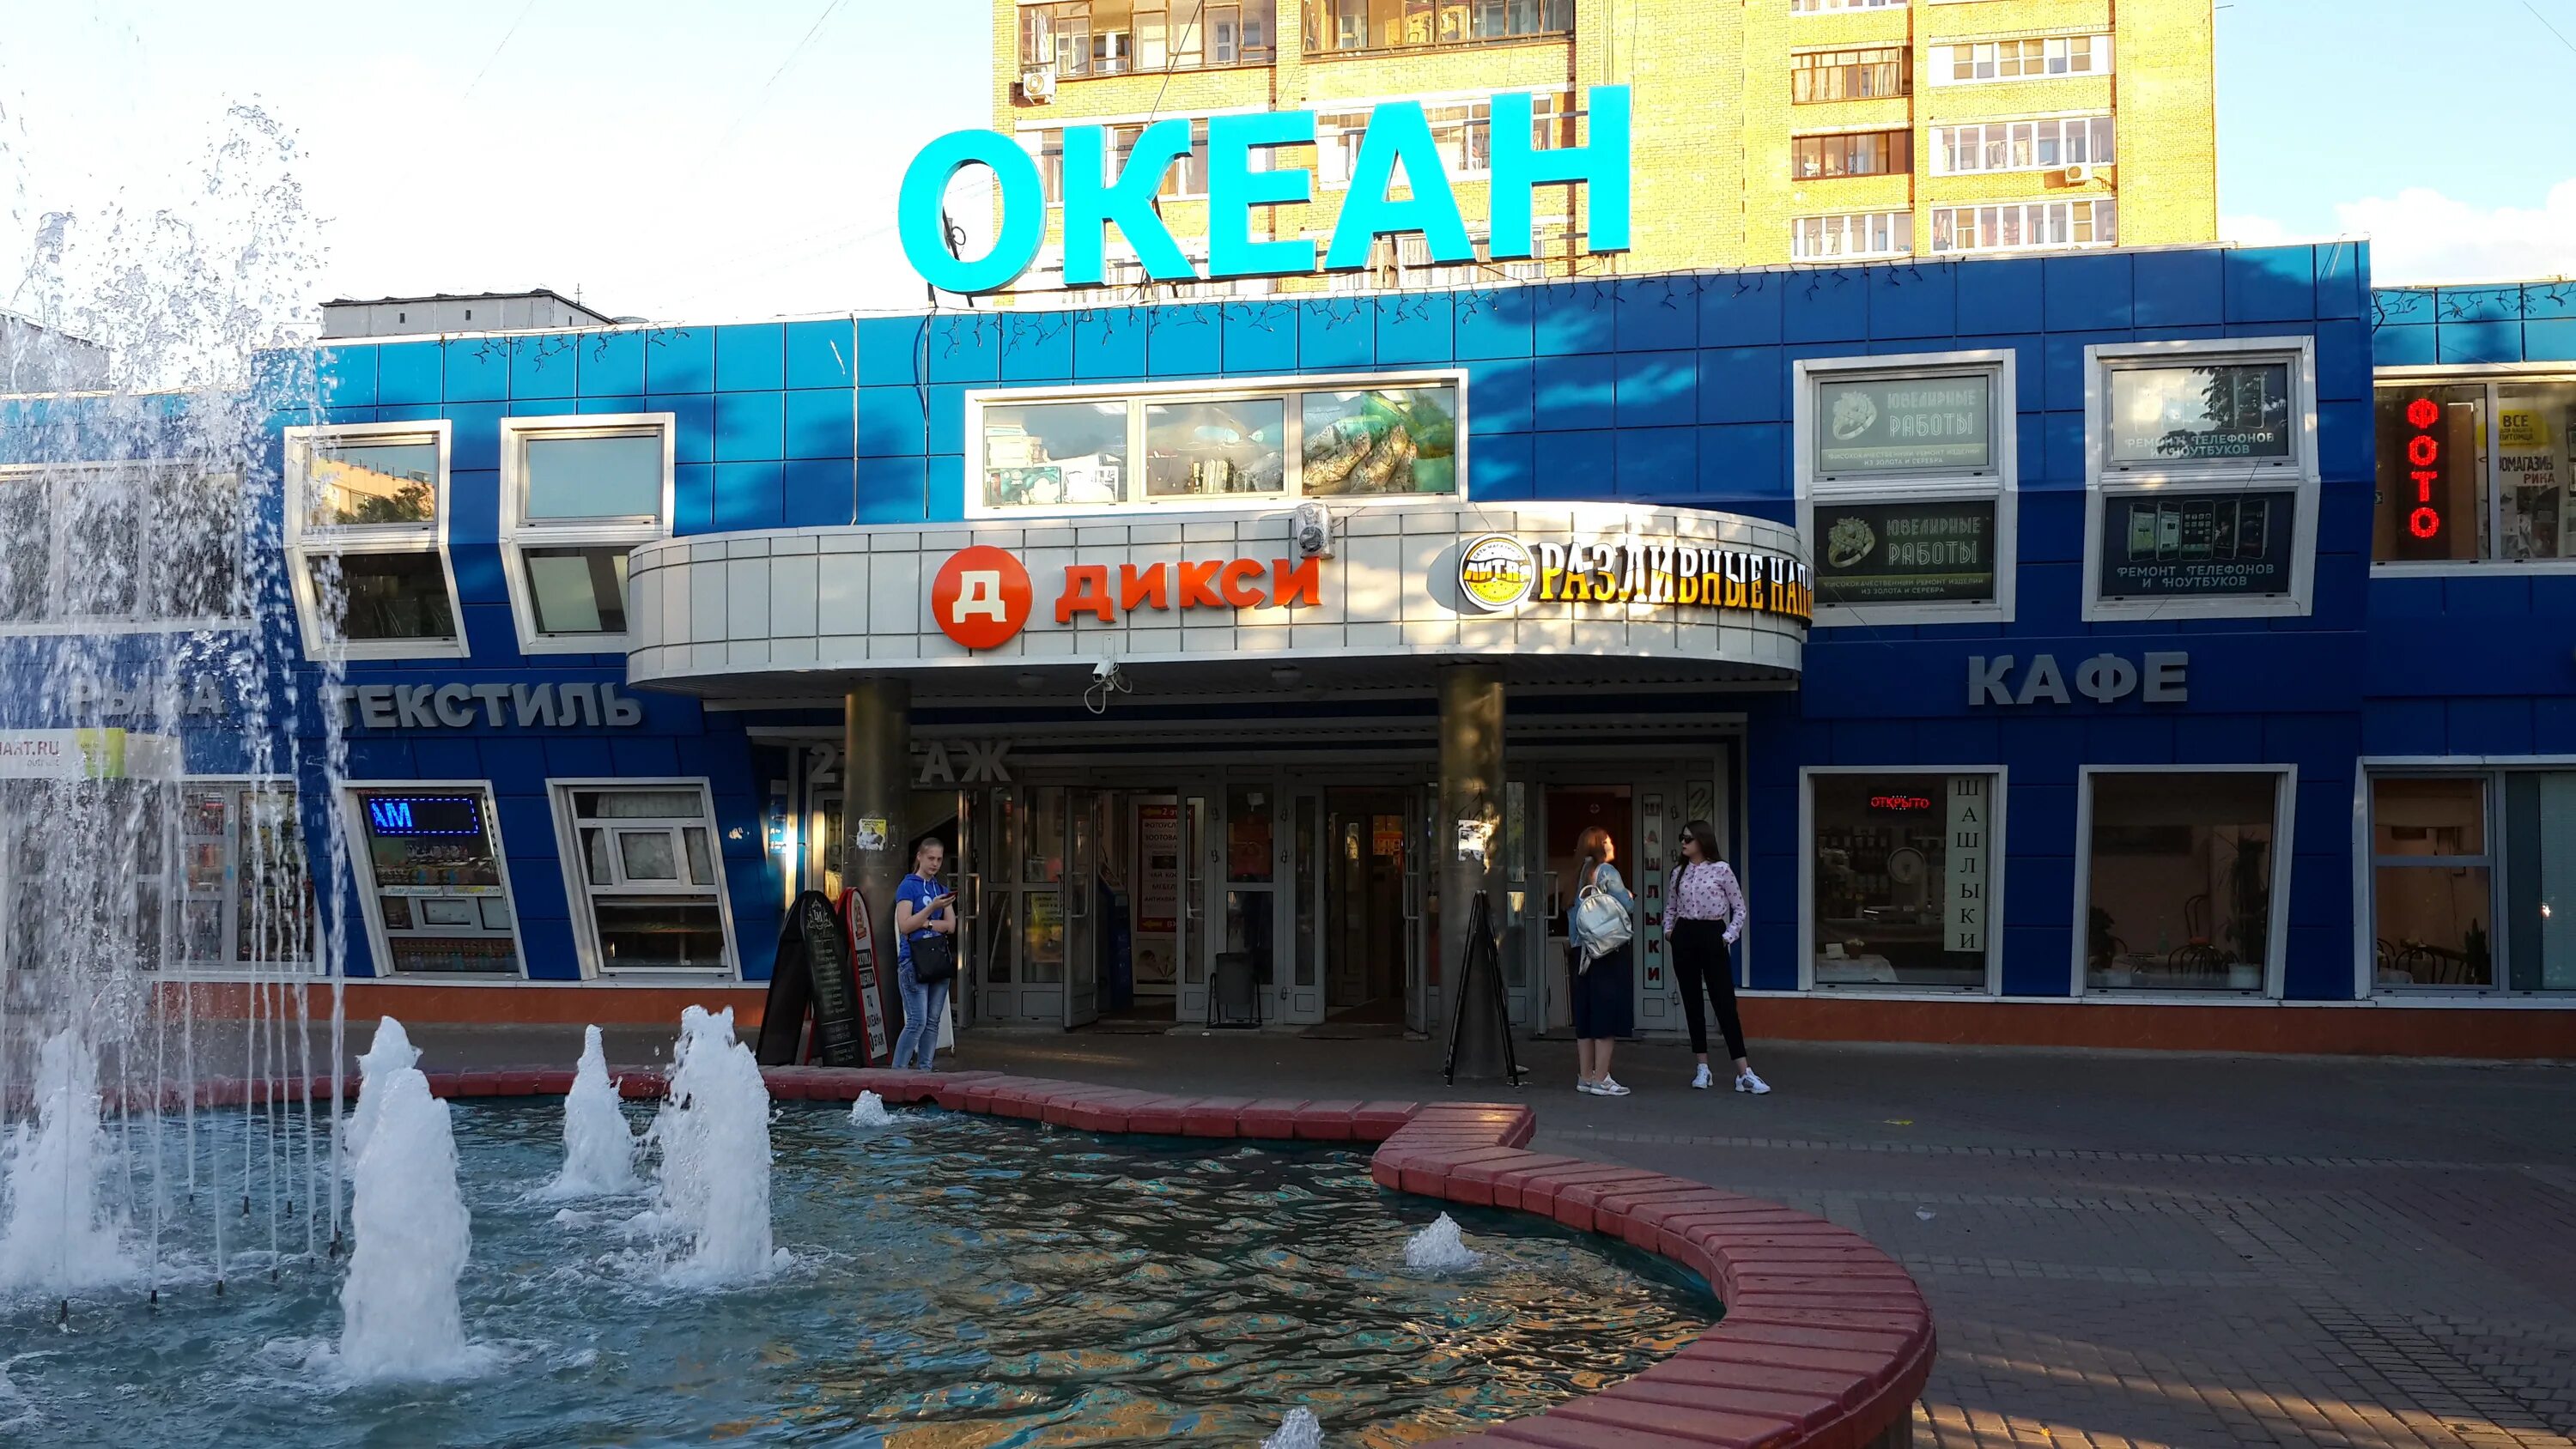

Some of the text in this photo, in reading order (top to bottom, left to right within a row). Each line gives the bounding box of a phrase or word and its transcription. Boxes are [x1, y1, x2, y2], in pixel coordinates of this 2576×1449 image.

[898, 84, 1631, 293] ОКЕАН
[1887, 390, 1976, 409] ЮВЕЛИРНЫЕ
[1890, 411, 1973, 438] РАБОТЫ
[2502, 415, 2529, 427] ВСЕ
[2150, 444, 2251, 458] И НОУТБУКОВ
[2190, 432, 2275, 446] ТЕЛЕФОНОВ
[2407, 397, 2439, 539] ФОТО
[1886, 516, 1981, 537] ЮВЕЛИРНЫЕ
[1889, 540, 1978, 567] РАБОТЫ
[1539, 542, 1812, 621] РАЗЛИВНЫЕ НАПИ
[2117, 563, 2275, 578] РЕМОНТ ТЕЛЕФОНОВ
[2142, 576, 2248, 588] И НОУТБУКОВ
[952, 570, 1007, 625] Д
[1054, 557, 1322, 625] ДИКСИ
[1873, 586, 1903, 595] ЗОЛОТА
[1911, 585, 1945, 594] СЕРЕБРА
[1968, 651, 2189, 706] КАФЕ
[318, 683, 642, 728] ТЕКСТИЛЬ
[810, 741, 1012, 783] 2 АЖ
[1870, 797, 1931, 809] ОТКРЫТО
[1145, 833, 1177, 841] ЗООТОВА
[1956, 779, 1981, 949] ШАШЛЫКИ
[1643, 802, 1663, 981] ШАШЛЫКИ
